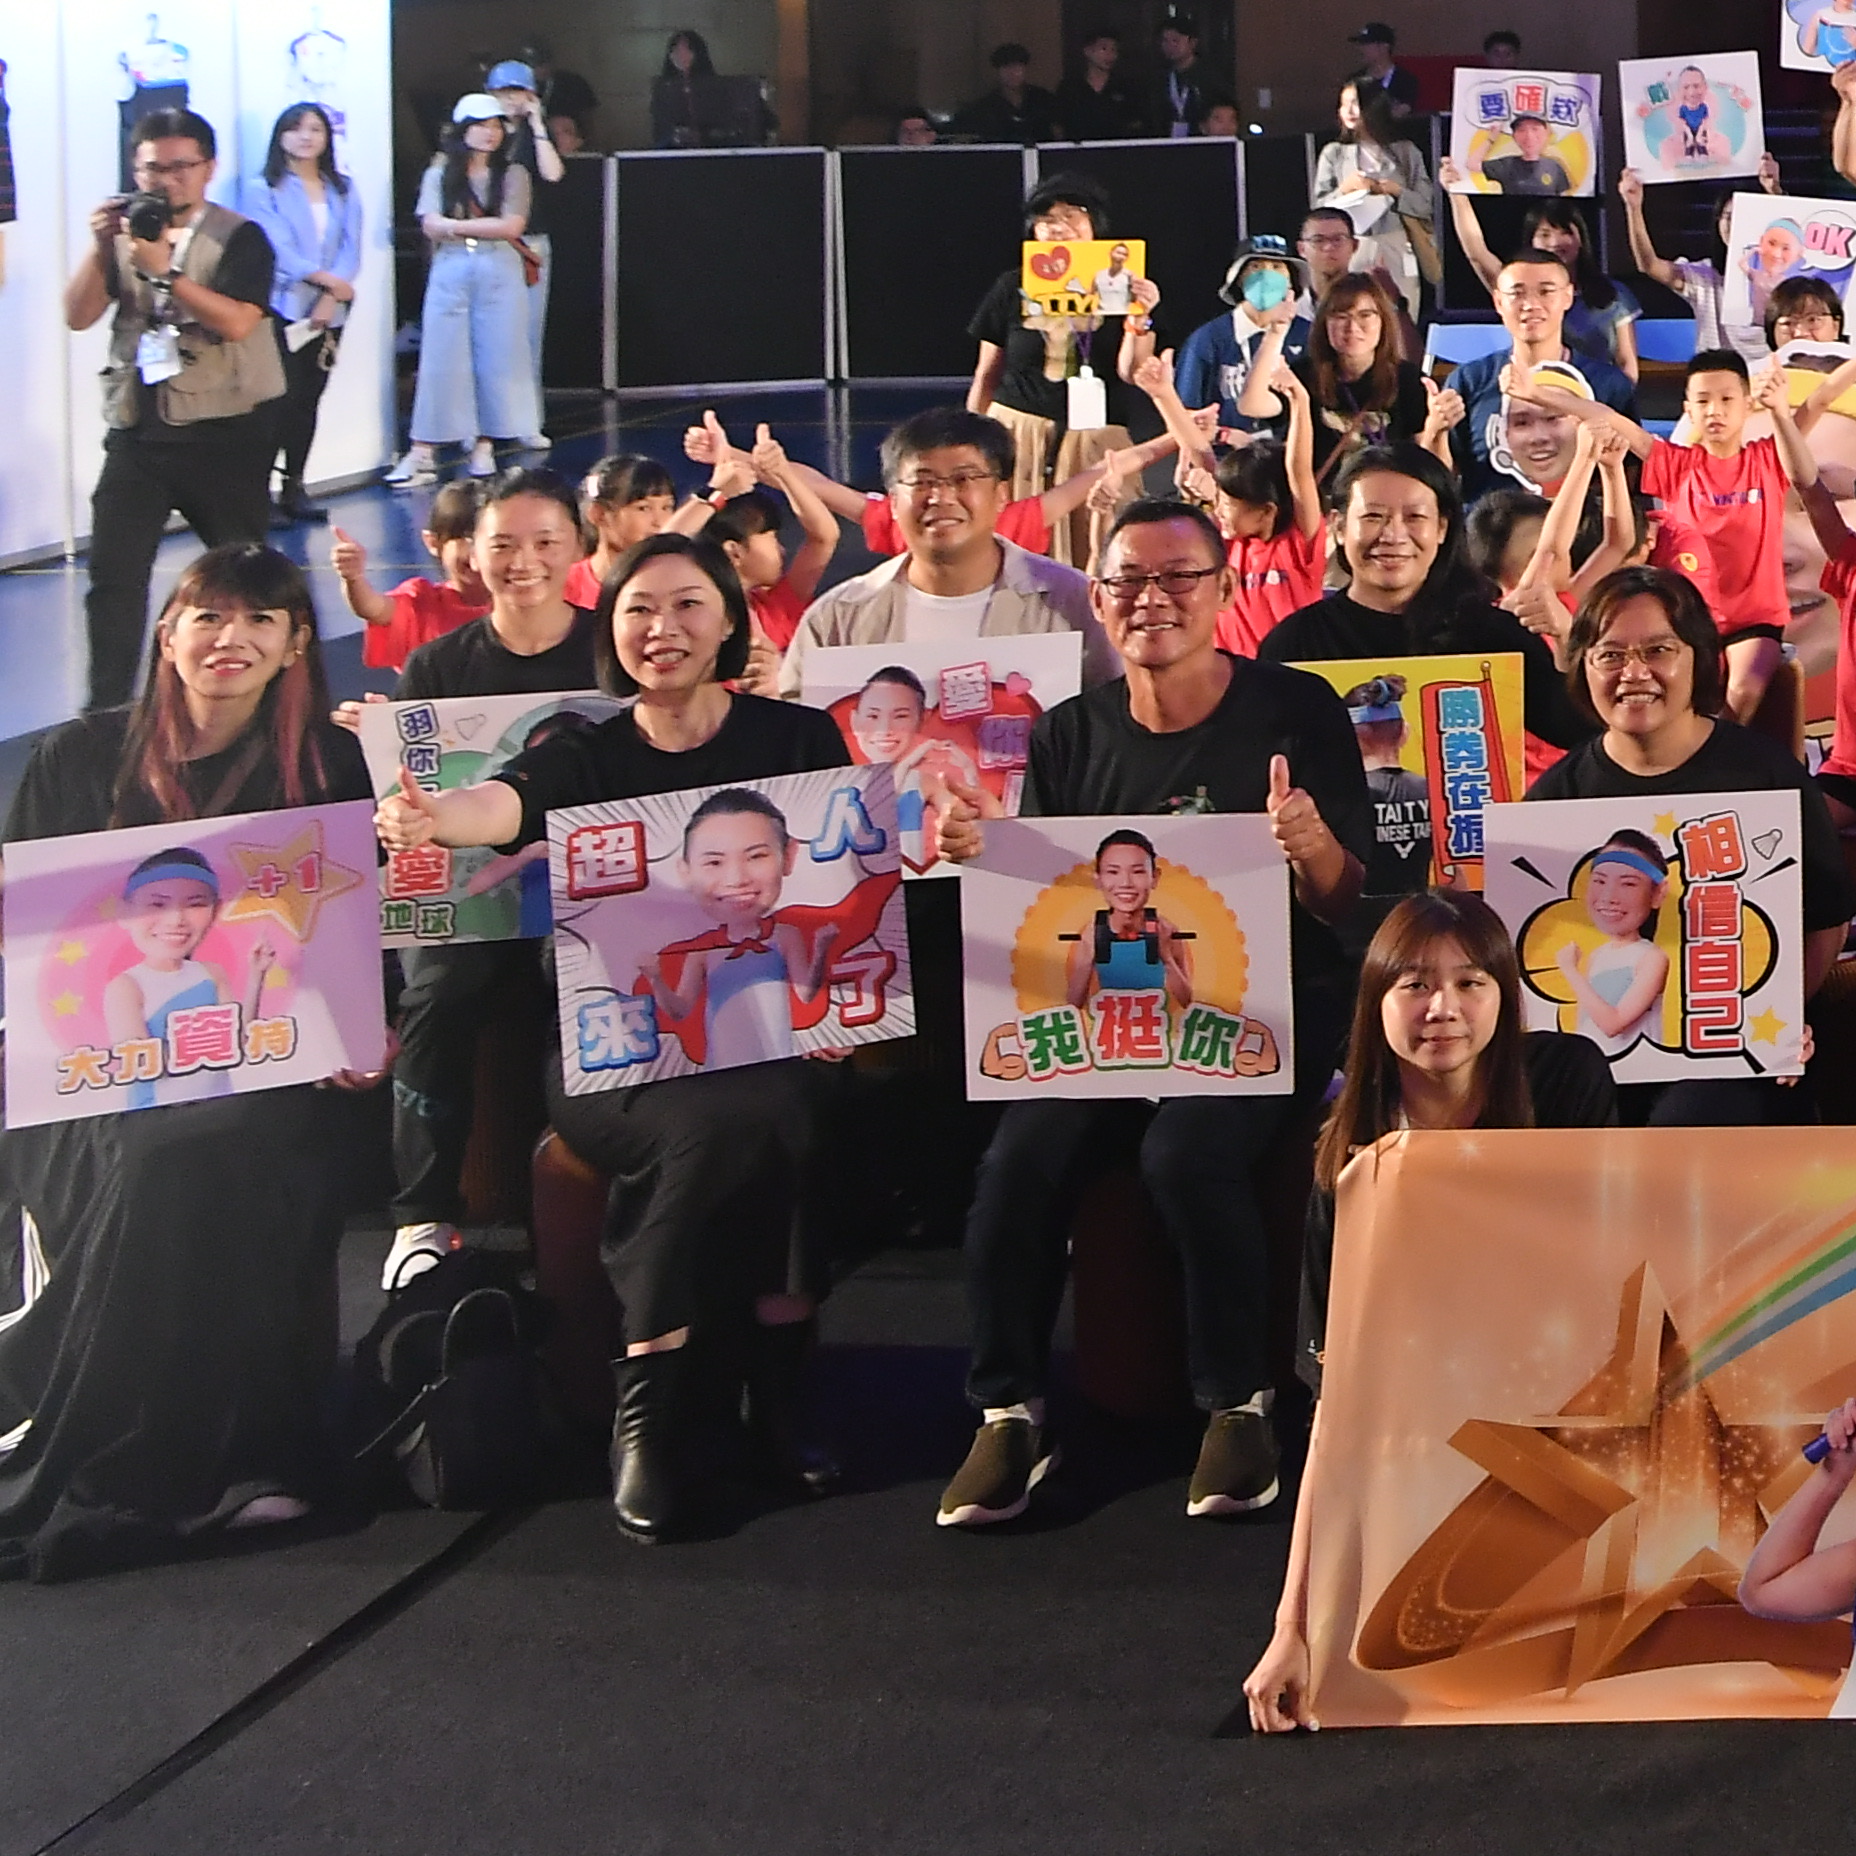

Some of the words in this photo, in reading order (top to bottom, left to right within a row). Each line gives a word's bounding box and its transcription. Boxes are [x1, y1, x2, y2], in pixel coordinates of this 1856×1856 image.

[1806, 221, 1852, 259] OK
[249, 854, 320, 897] +1
[384, 904, 451, 933] 地球
[1684, 812, 1744, 1054] 相信自己
[59, 1007, 297, 1093] 大力資持
[1022, 995, 1245, 1070] 我挺你
